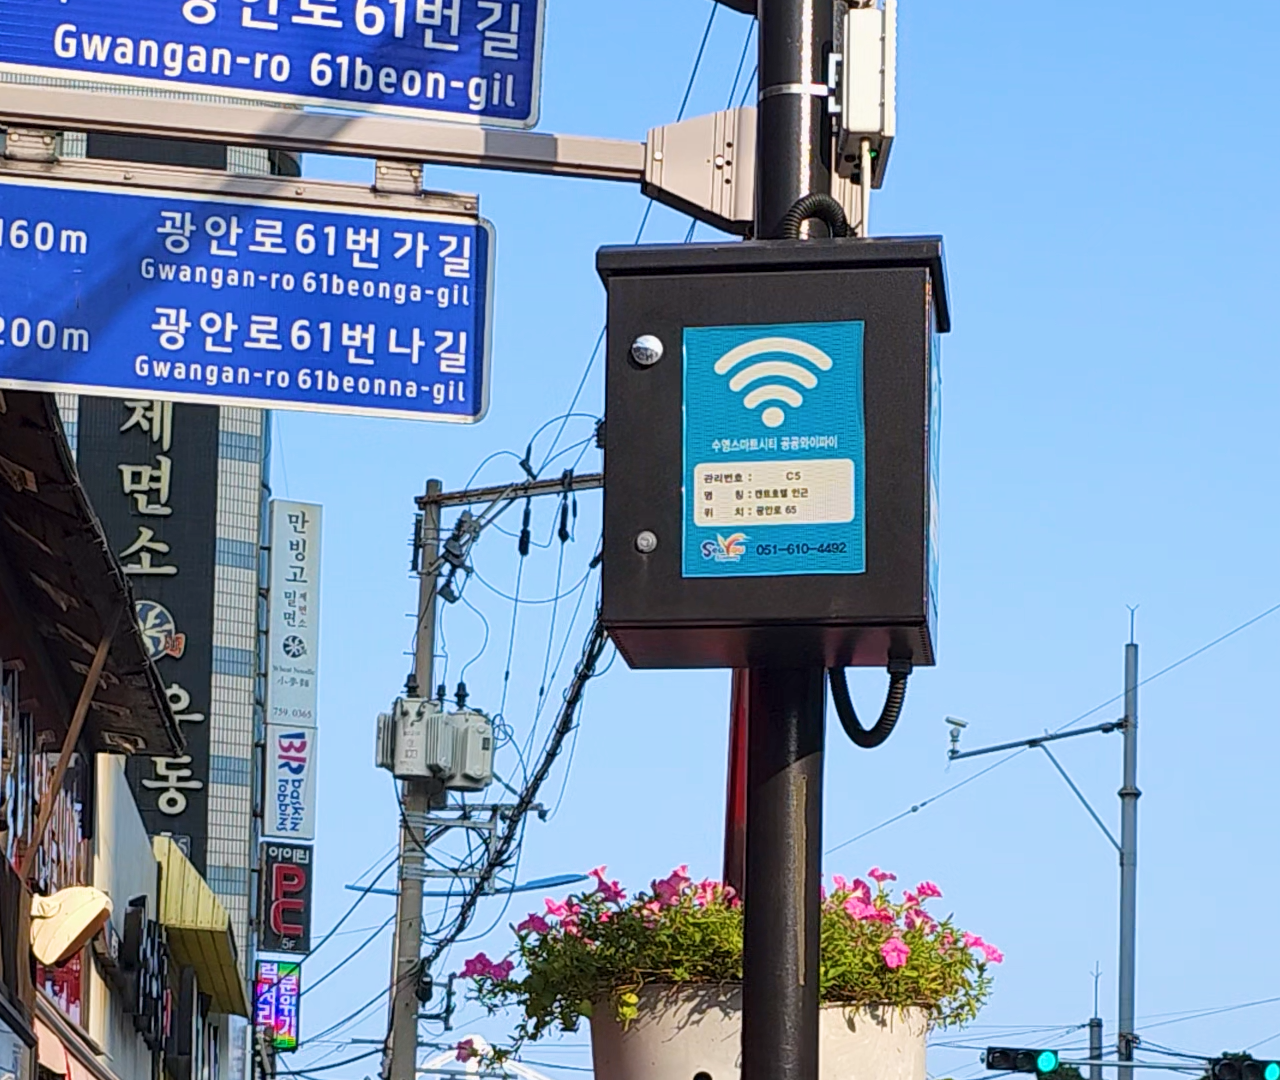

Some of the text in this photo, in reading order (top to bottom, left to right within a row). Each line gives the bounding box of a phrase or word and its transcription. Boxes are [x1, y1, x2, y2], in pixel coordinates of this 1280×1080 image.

[53, 24, 517, 111] Gwangan-ro 61beon-gil
[156, 210, 472, 279] 광안로61번가길
[140, 257, 471, 309] Gwangan-ro 61beonga-gil
[151, 306, 469, 375] 광안로61번나길
[134, 354, 466, 405] Gwangan-ro 61beonna-gil
[785, 471, 801, 481] C5
[785, 505, 797, 515] 65
[276, 777, 290, 834] robbins
[289, 777, 307, 834] baskin
